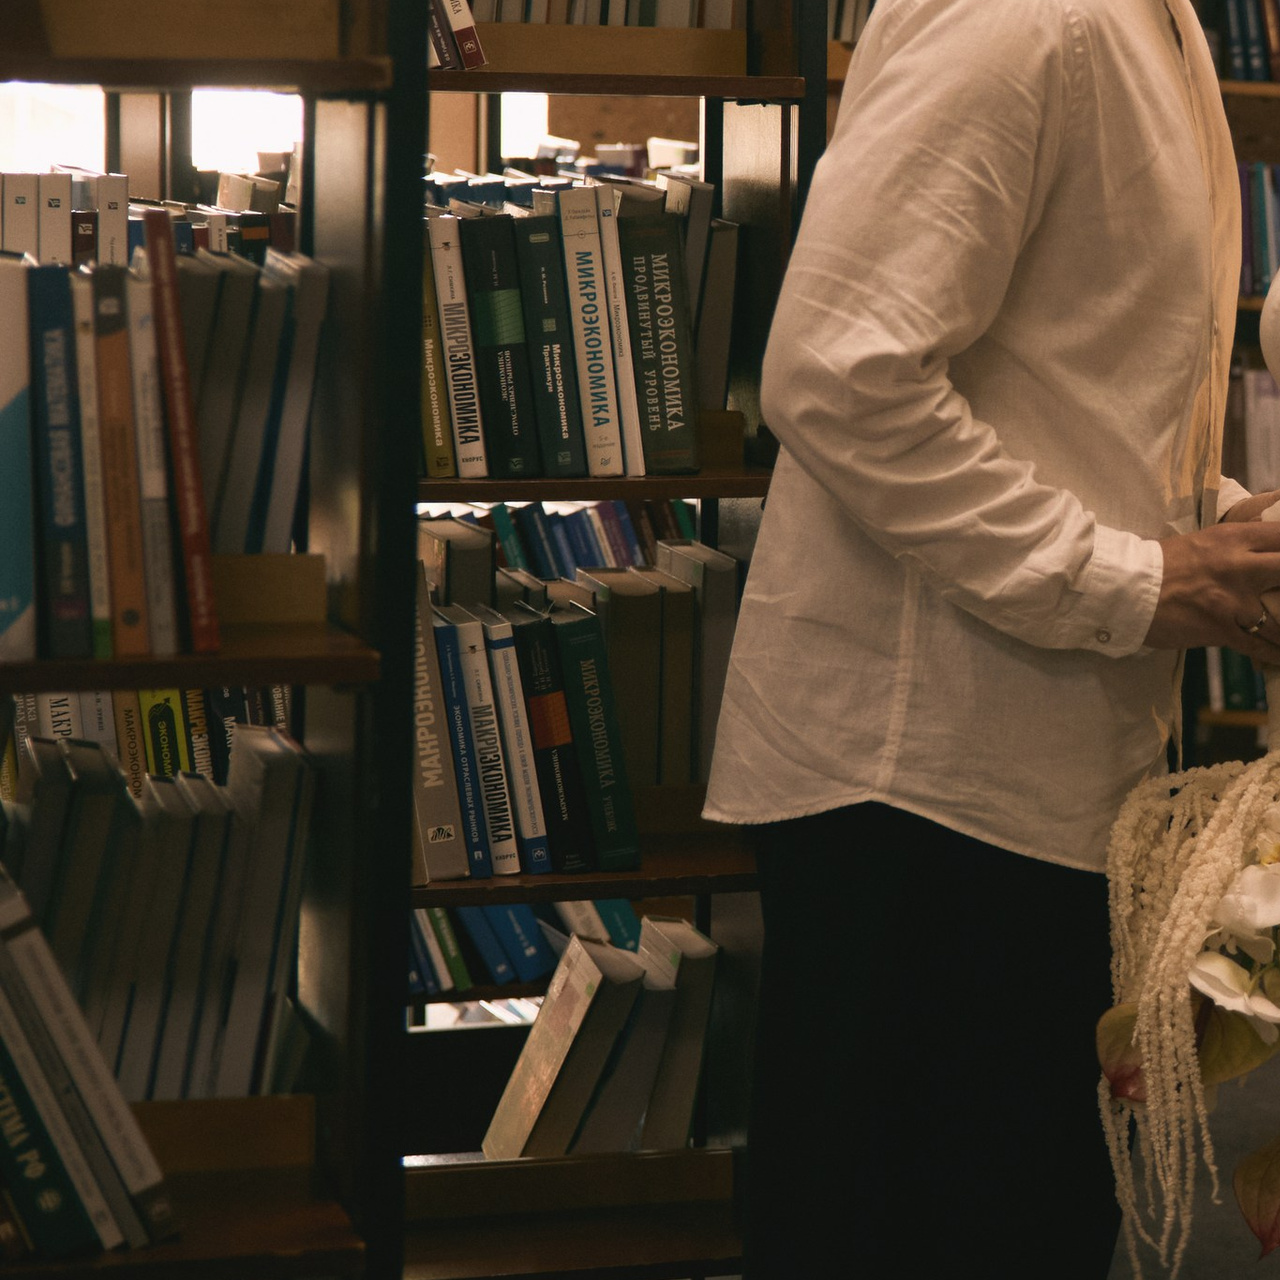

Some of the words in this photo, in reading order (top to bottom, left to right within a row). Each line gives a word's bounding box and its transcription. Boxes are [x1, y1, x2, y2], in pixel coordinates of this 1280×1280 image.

[613, 304, 625, 357] Микроэкономика
[633, 255, 656, 359] ПРОДВИНУТЫЙ
[504, 350, 513, 384] РЫНКОВ
[542, 344, 555, 393] Практикум
[575, 251, 610, 427] МИКРОЭКОНОМИКА
[651, 252, 685, 431] МИКРОЭКОНОМИКА
[424, 338, 445, 448] Микроэкономика
[443, 302, 480, 446] МИКРОЭКОНОМИКА
[497, 350, 508, 401] ЭКОНОМИКА
[551, 343, 571, 439] Микроэкономика
[643, 370, 661, 431] УРОВЕНЬ
[508, 385, 519, 436] ОТРАСЛЕВЫХ
[271, 686, 287, 722] ОВАНИЕ
[453, 704, 468, 755] ЭКОНОМИКА
[123, 708, 144, 799] МАКРОЭКОНОМ
[157, 720, 174, 778] ЭКОНОМИ
[471, 703, 513, 844] МАКРОЭКОНОМИКА
[579, 658, 616, 789] МИКРОЭКОНОМИКА
[602, 795, 618, 833] УЧЕБНИК
[460, 756, 475, 809] ОТРАСЛЕВЫХ
[551, 748, 569, 821] МАКРОЭКОНОМИКА
[466, 809, 480, 844] РЫНКОВ
